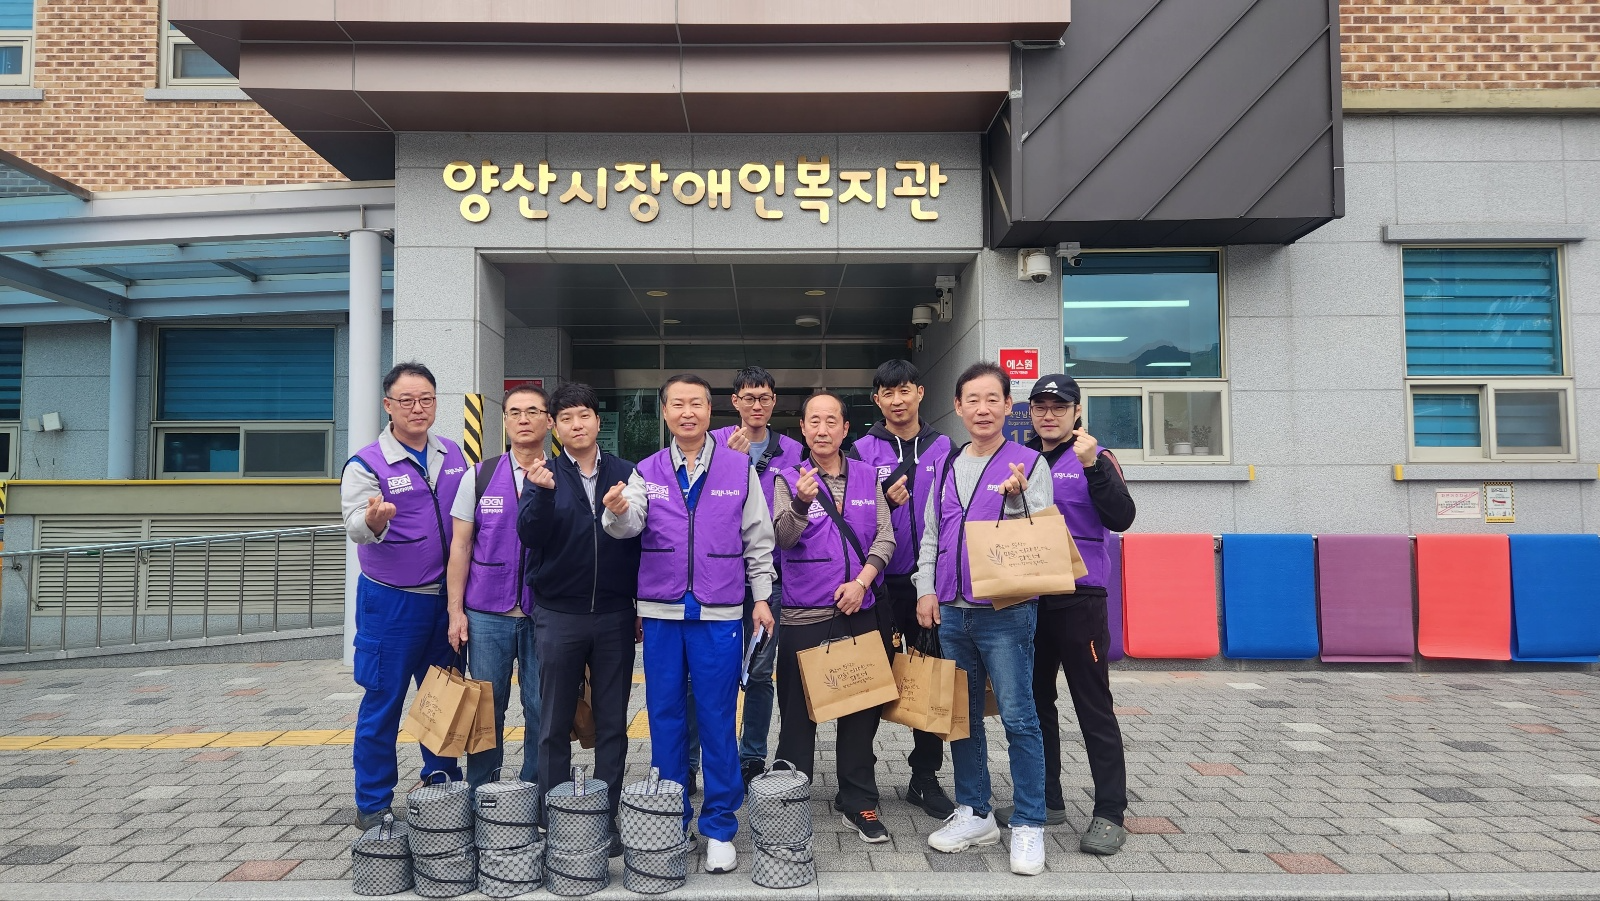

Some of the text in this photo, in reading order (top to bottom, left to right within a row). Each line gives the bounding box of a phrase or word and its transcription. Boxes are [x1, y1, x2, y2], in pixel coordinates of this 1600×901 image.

[443, 156, 948, 223] 양산시장애인복지관
[1006, 359, 1033, 370] 에스원
[387, 475, 412, 489] NEXEN
[646, 484, 669, 495] NEXEN
[480, 498, 504, 506] NEXEN
